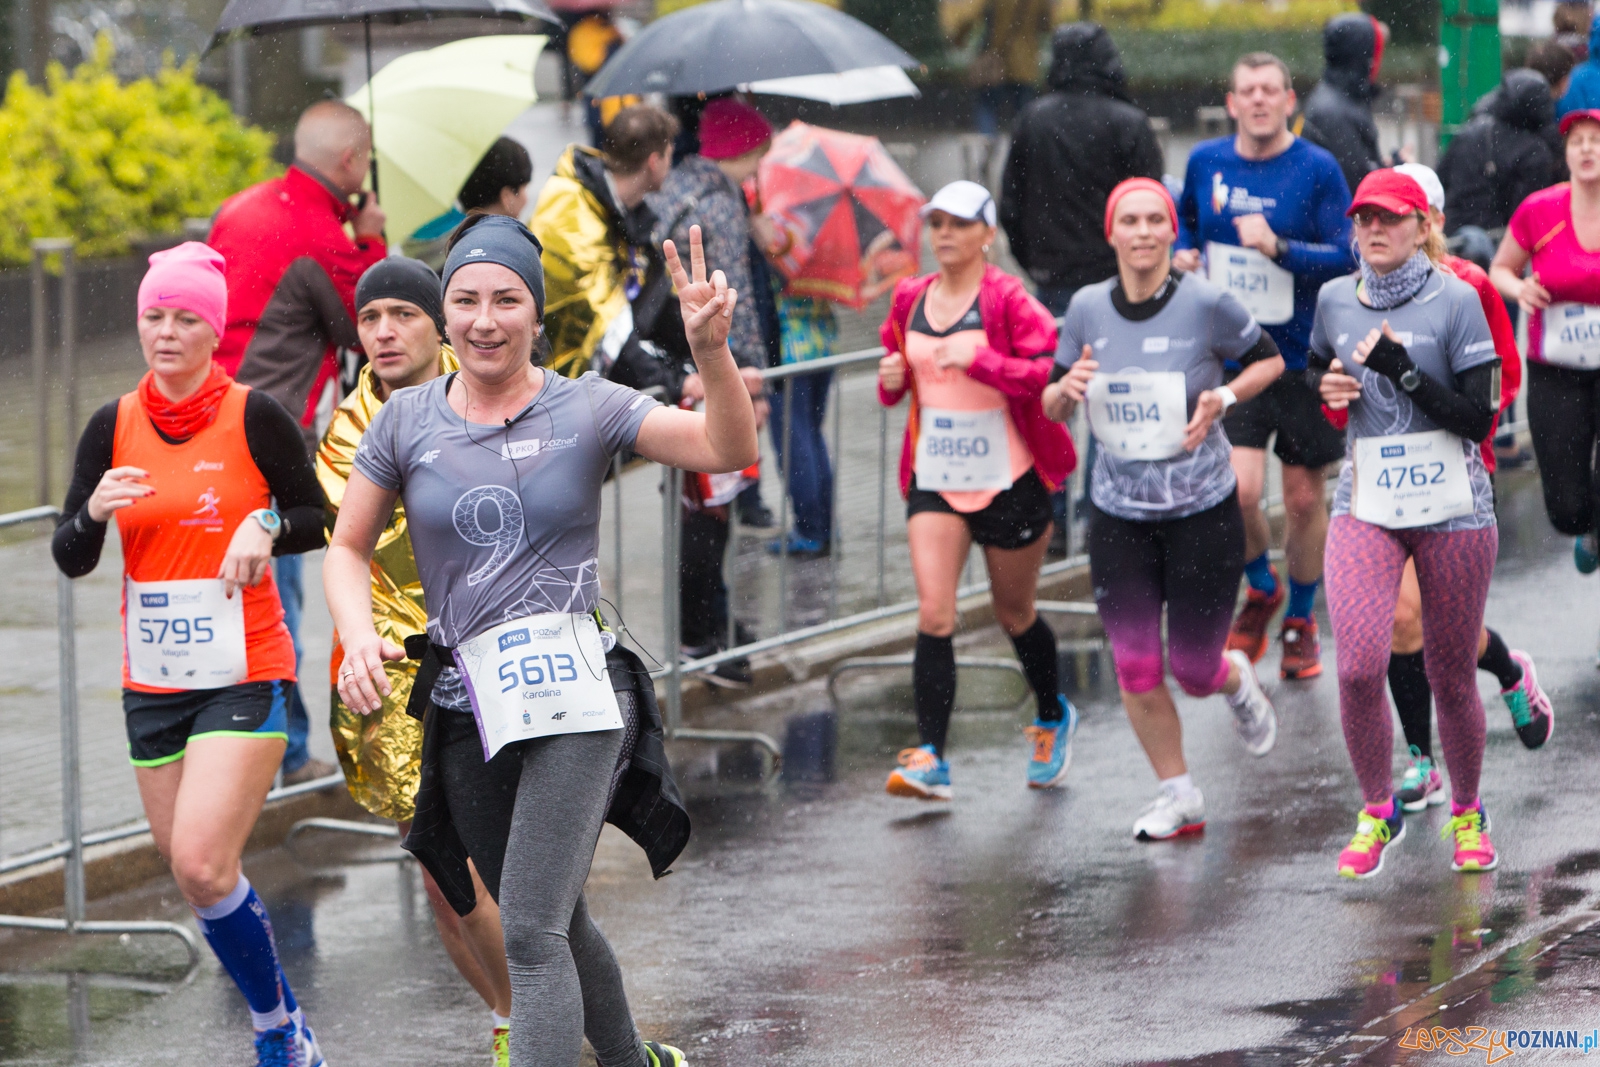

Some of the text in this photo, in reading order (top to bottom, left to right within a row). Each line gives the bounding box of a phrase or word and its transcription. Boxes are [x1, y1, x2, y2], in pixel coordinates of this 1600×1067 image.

[1106, 402, 1160, 423] 11614
[926, 435, 989, 457] 8860
[1376, 461, 1446, 489] 4762
[452, 484, 525, 586] 9
[139, 617, 214, 644] 5795
[499, 653, 578, 693] 5613
[522, 688, 562, 700] Karolina
